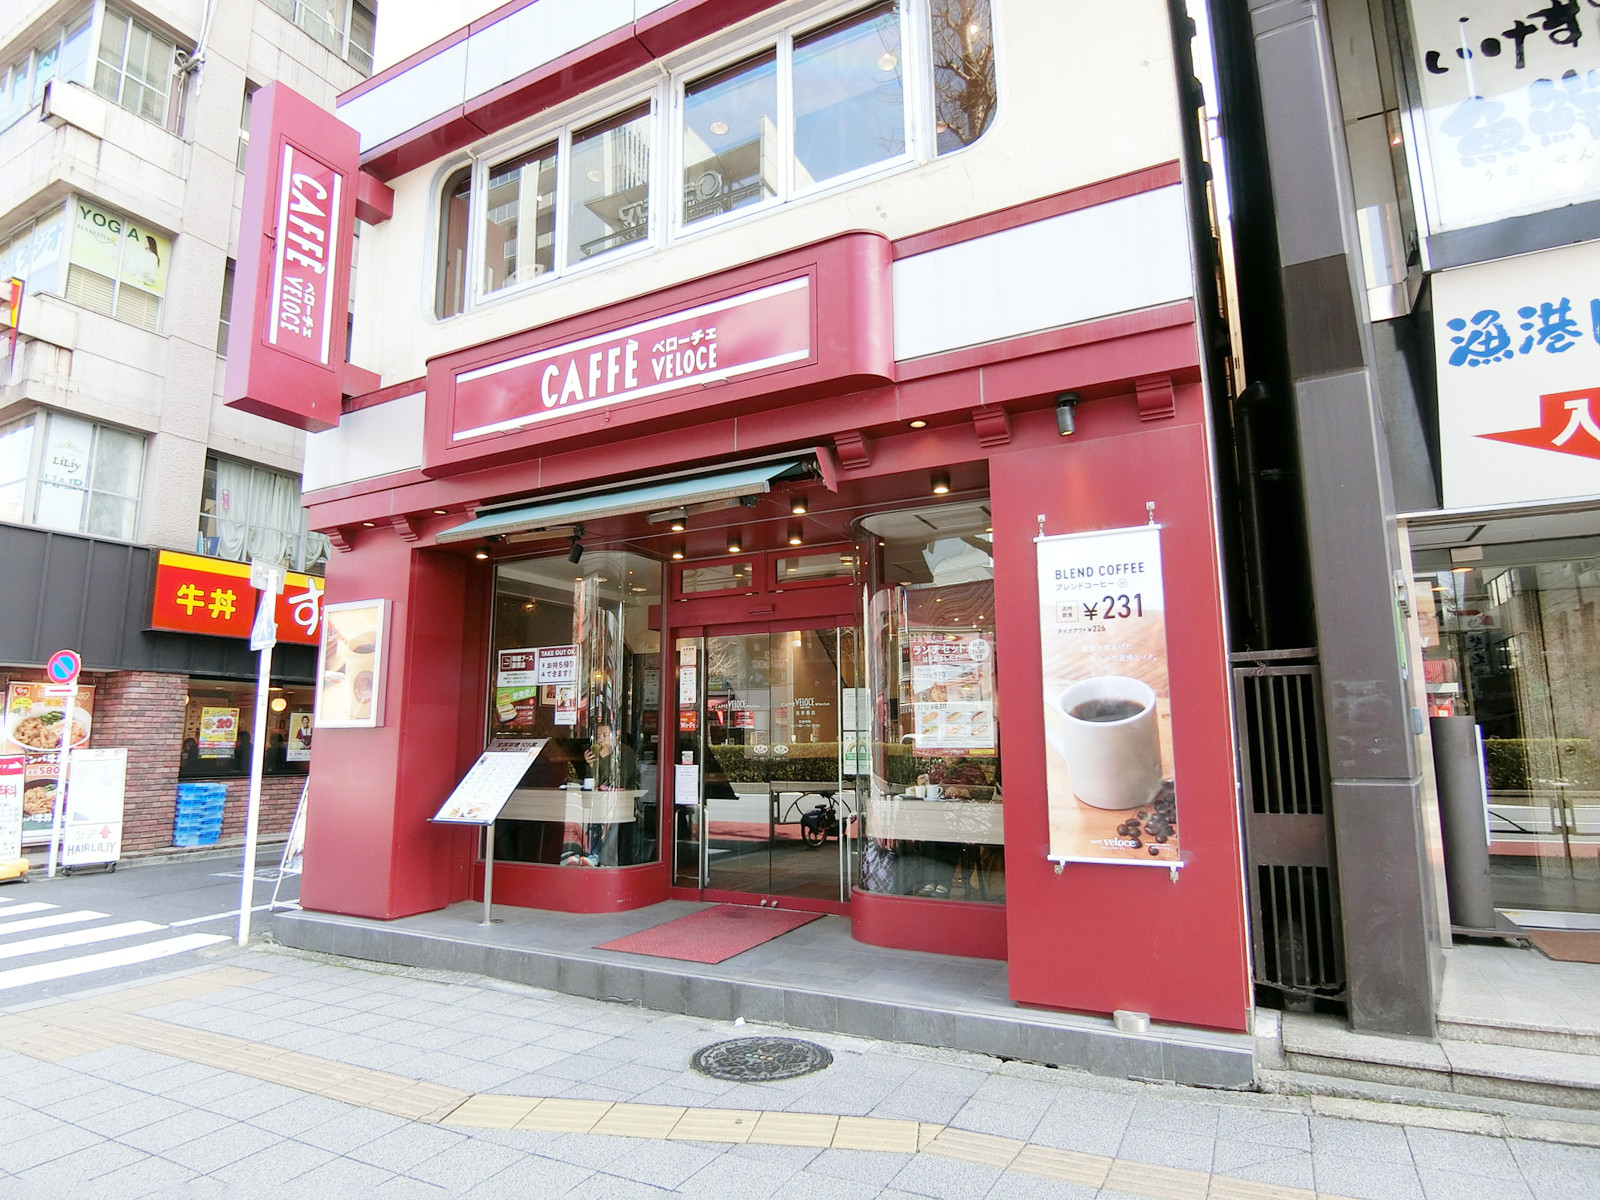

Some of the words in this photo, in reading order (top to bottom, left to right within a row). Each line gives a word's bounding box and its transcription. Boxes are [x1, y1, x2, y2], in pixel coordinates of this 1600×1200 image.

[1425, 0, 1600, 74] いけす
[80, 205, 140, 242] YOGA
[280, 275, 304, 335] VELOCE
[302, 282, 316, 338] ベローチェ
[652, 327, 717, 353] ベローチェ
[1446, 297, 1600, 368] 漁港
[540, 337, 639, 408] CAFFÈ
[651, 343, 717, 381] VELOCE
[1055, 566, 1094, 580] BLEND
[1098, 562, 1145, 577] COFFEE
[1056, 580, 1115, 591] ブレンドコーヒー
[176, 584, 237, 619] 牛丼
[288, 577, 325, 636] す
[1082, 593, 1143, 621] ¥231
[567, 647, 576, 655] OK
[0, 784, 17, 798] 科
[75, 828, 97, 840] 2F
[1103, 837, 1136, 847] veloce
